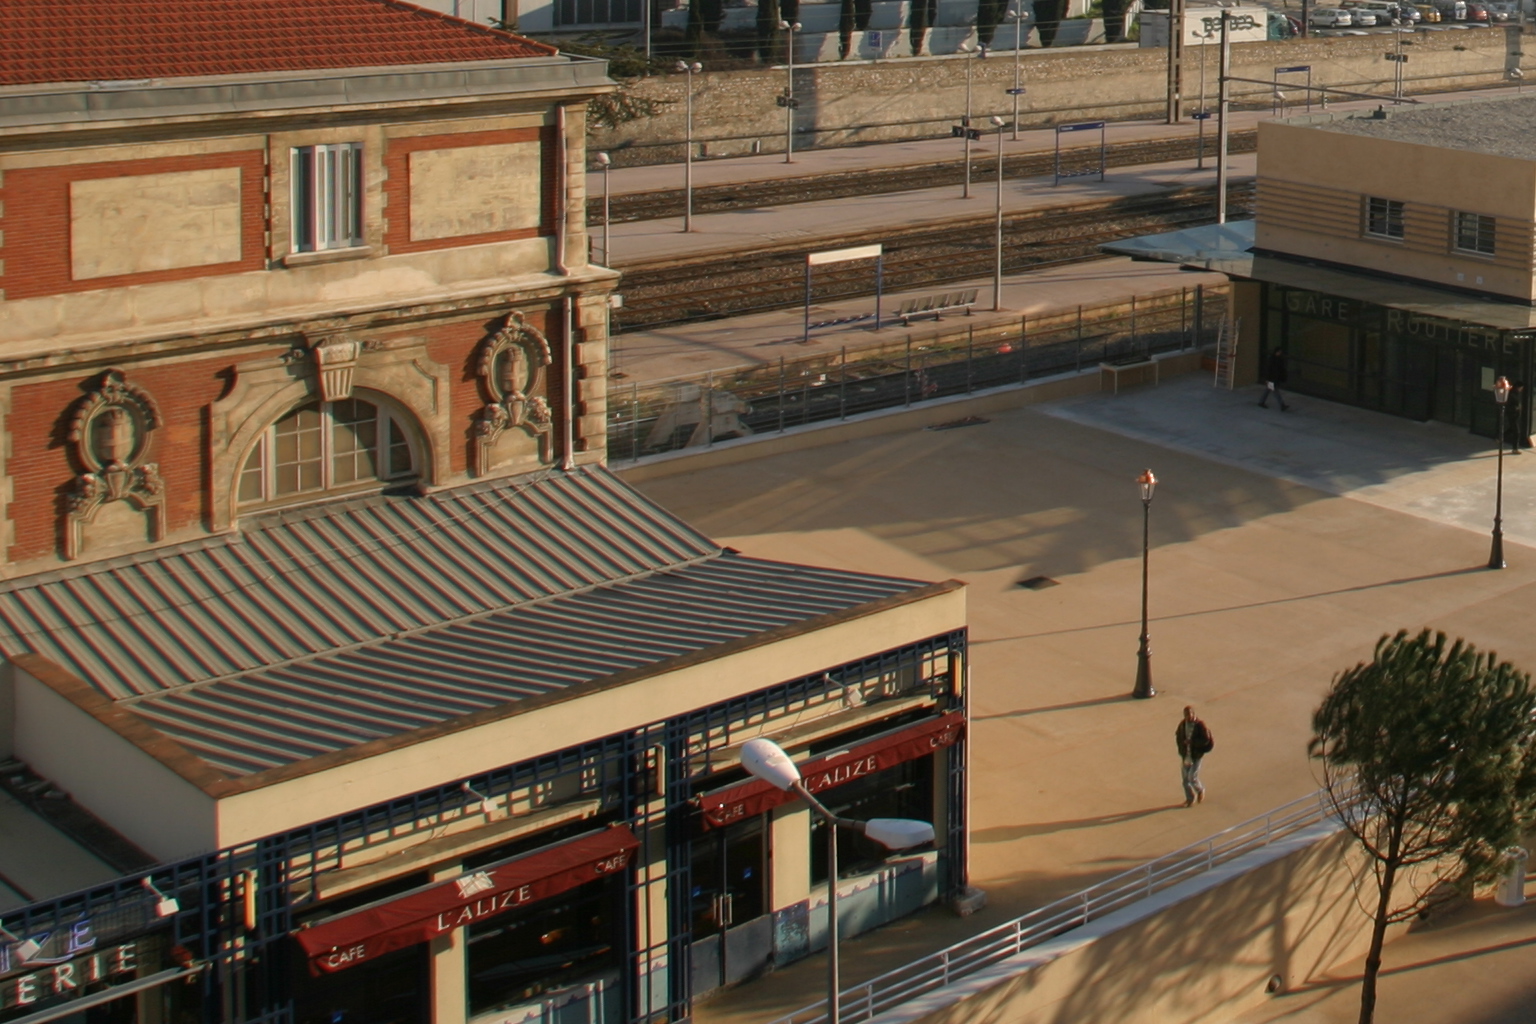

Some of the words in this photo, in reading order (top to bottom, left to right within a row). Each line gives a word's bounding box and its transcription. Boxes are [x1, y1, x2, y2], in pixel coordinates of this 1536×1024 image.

[1285, 290, 1349, 321] GARE
[437, 884, 532, 932] L'ALIZE
[15, 942, 138, 1006] ERIE
[328, 944, 366, 968] CAFE
